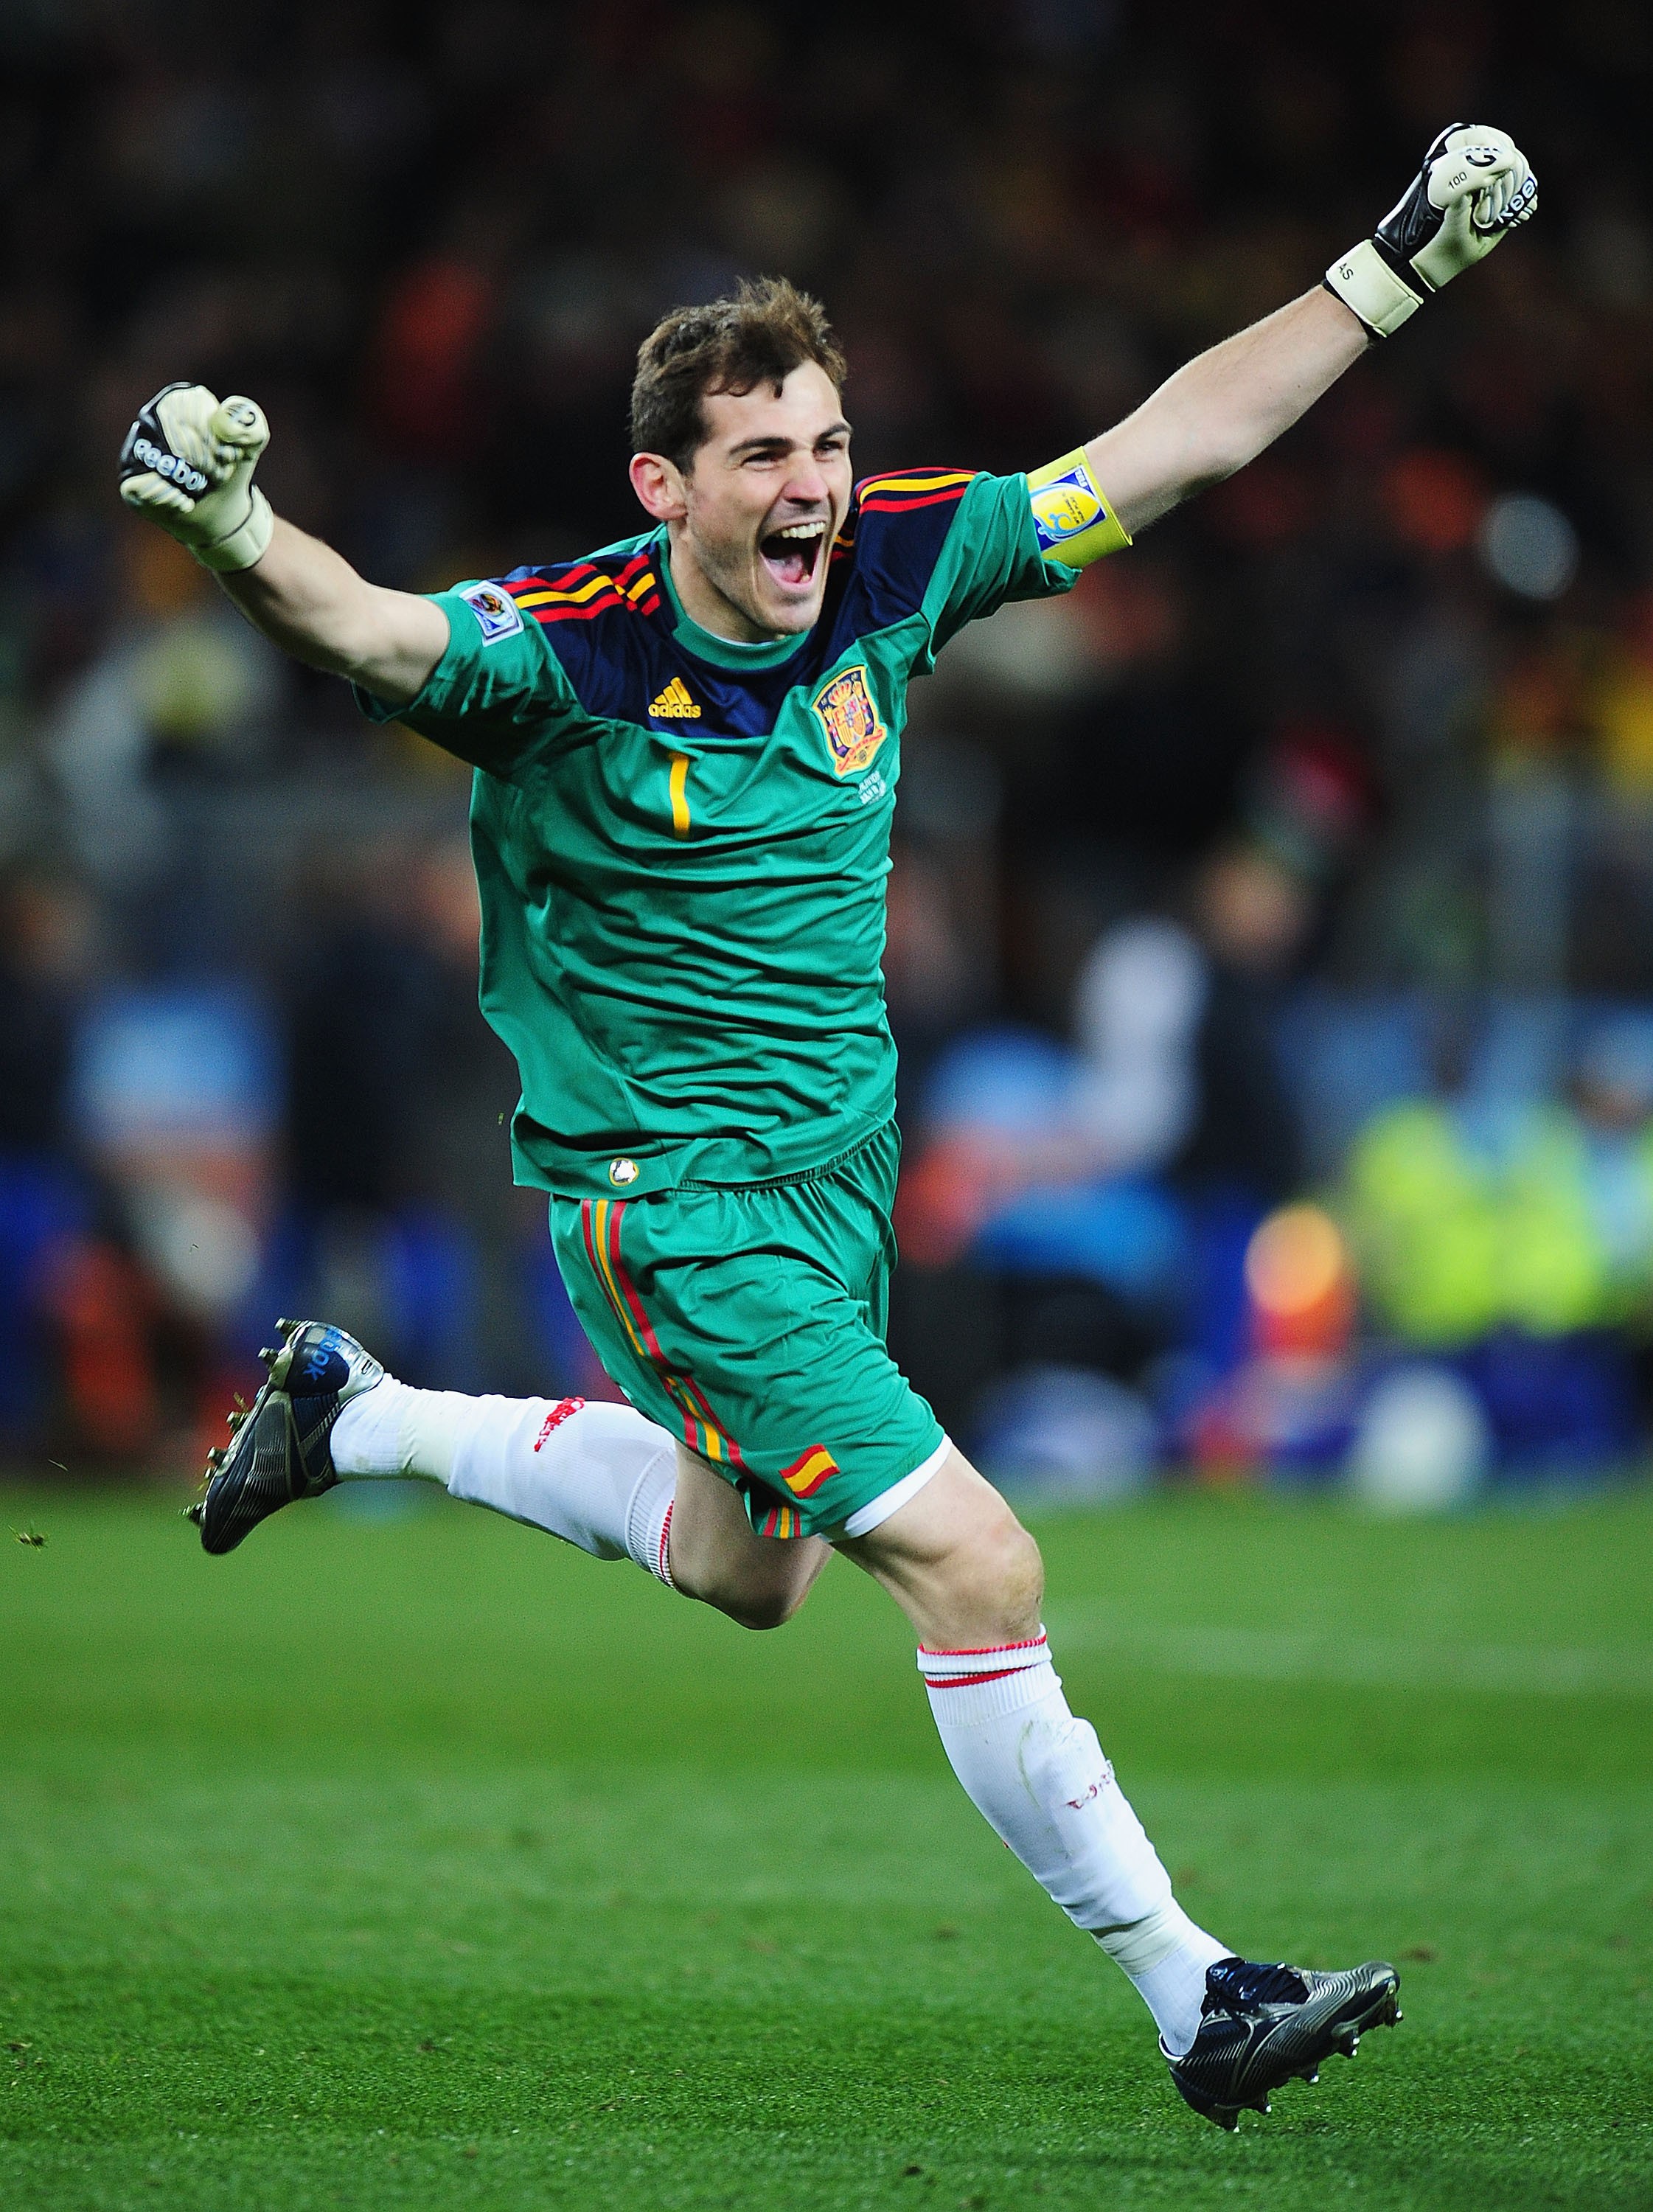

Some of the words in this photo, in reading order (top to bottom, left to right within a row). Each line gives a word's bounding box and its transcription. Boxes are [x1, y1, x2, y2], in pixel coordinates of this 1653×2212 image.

[1448, 171, 1467, 189] 100
[648, 702, 701, 718] adidas
[668, 751, 691, 839] 1
